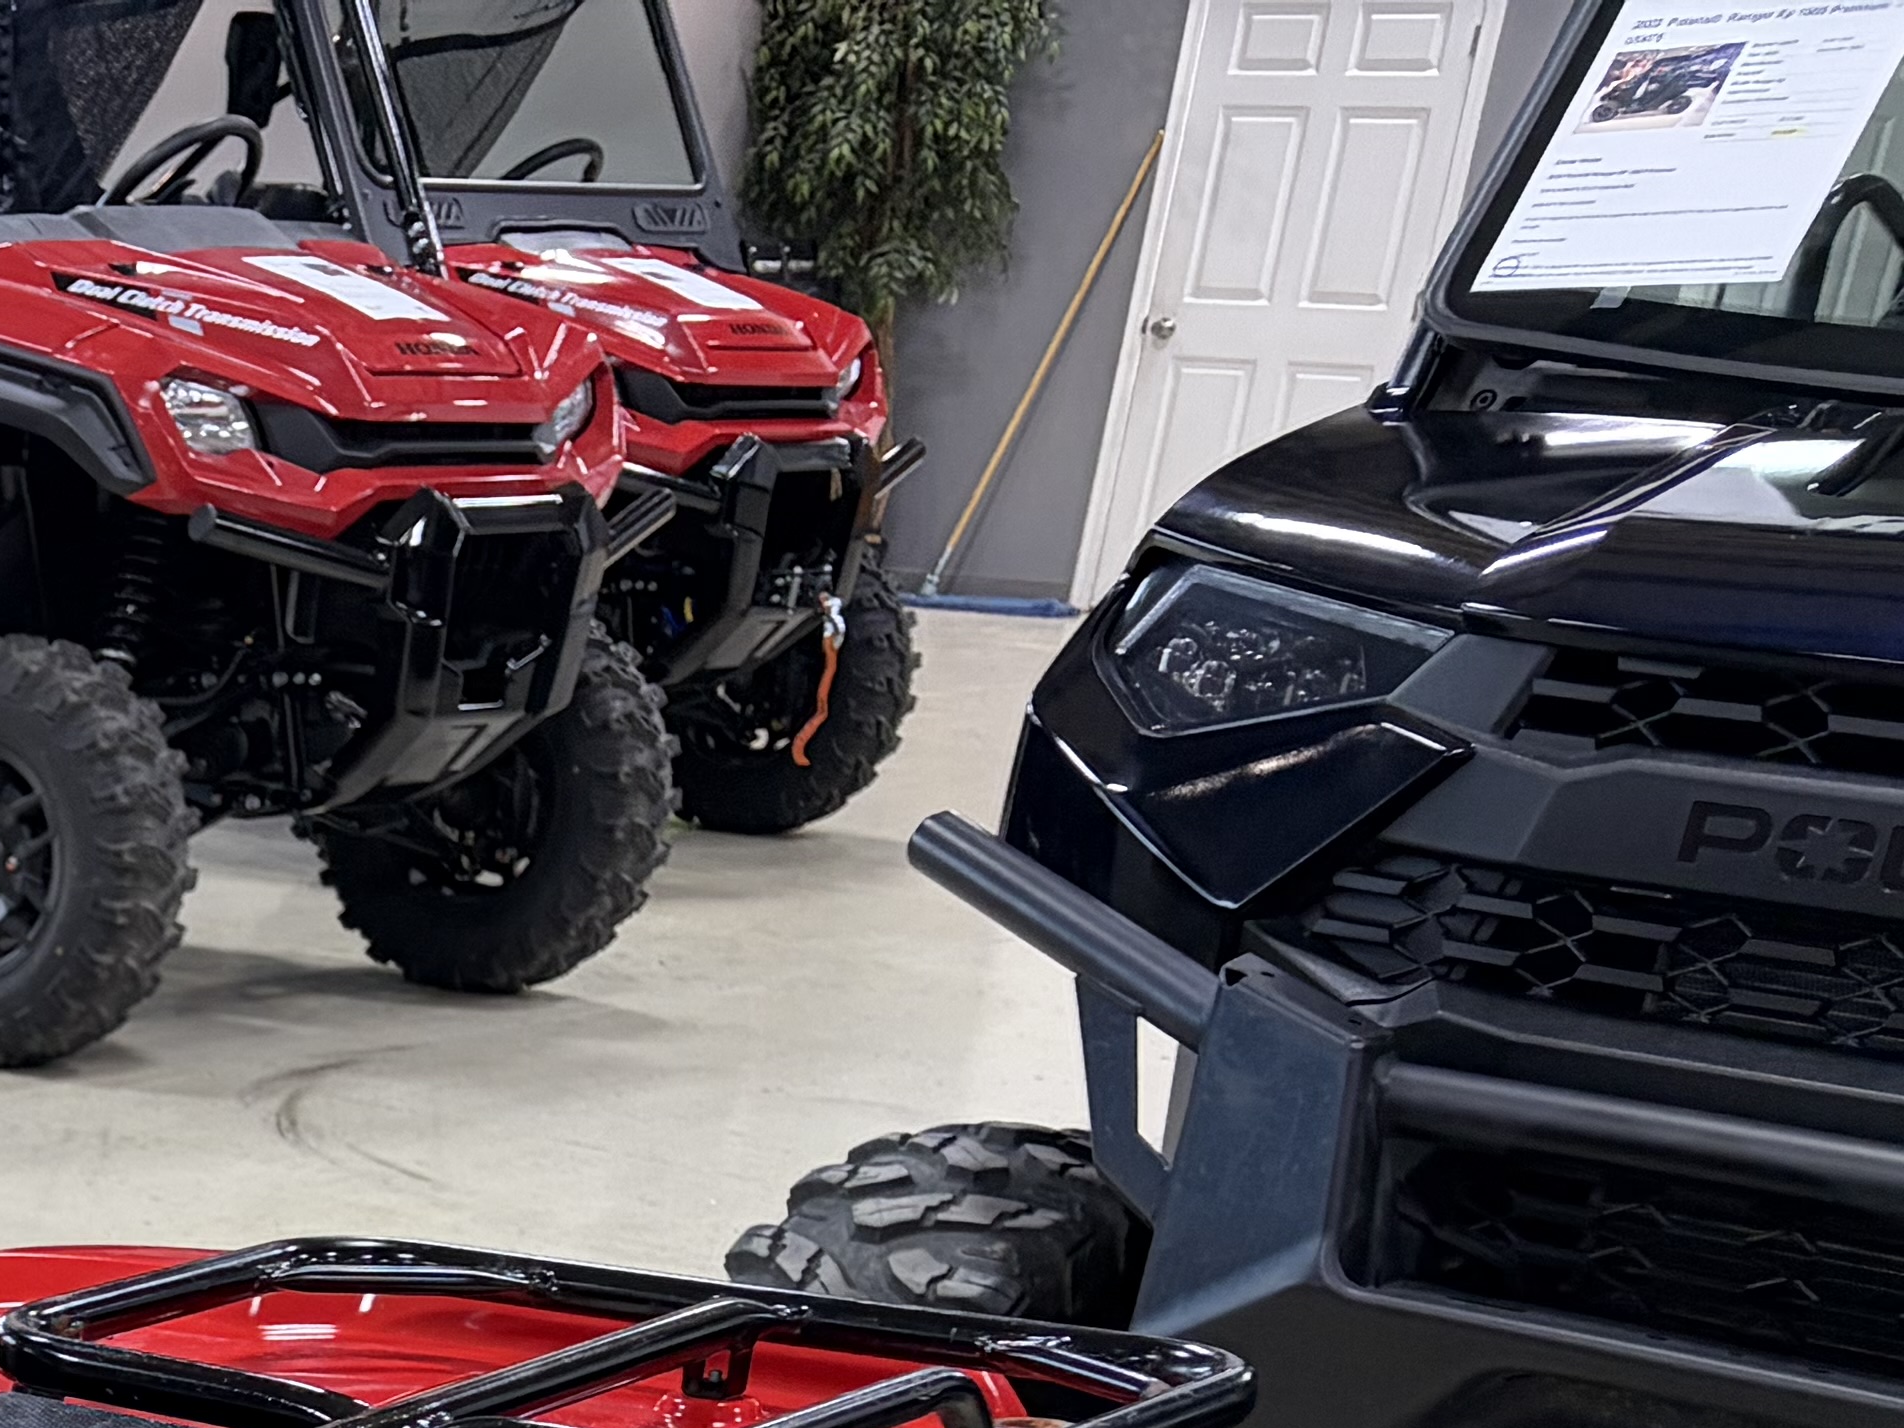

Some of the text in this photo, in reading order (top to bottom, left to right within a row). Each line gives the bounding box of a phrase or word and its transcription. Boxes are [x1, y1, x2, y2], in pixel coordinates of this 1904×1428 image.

[66, 278, 321, 348] Dual Clutch Transmission
